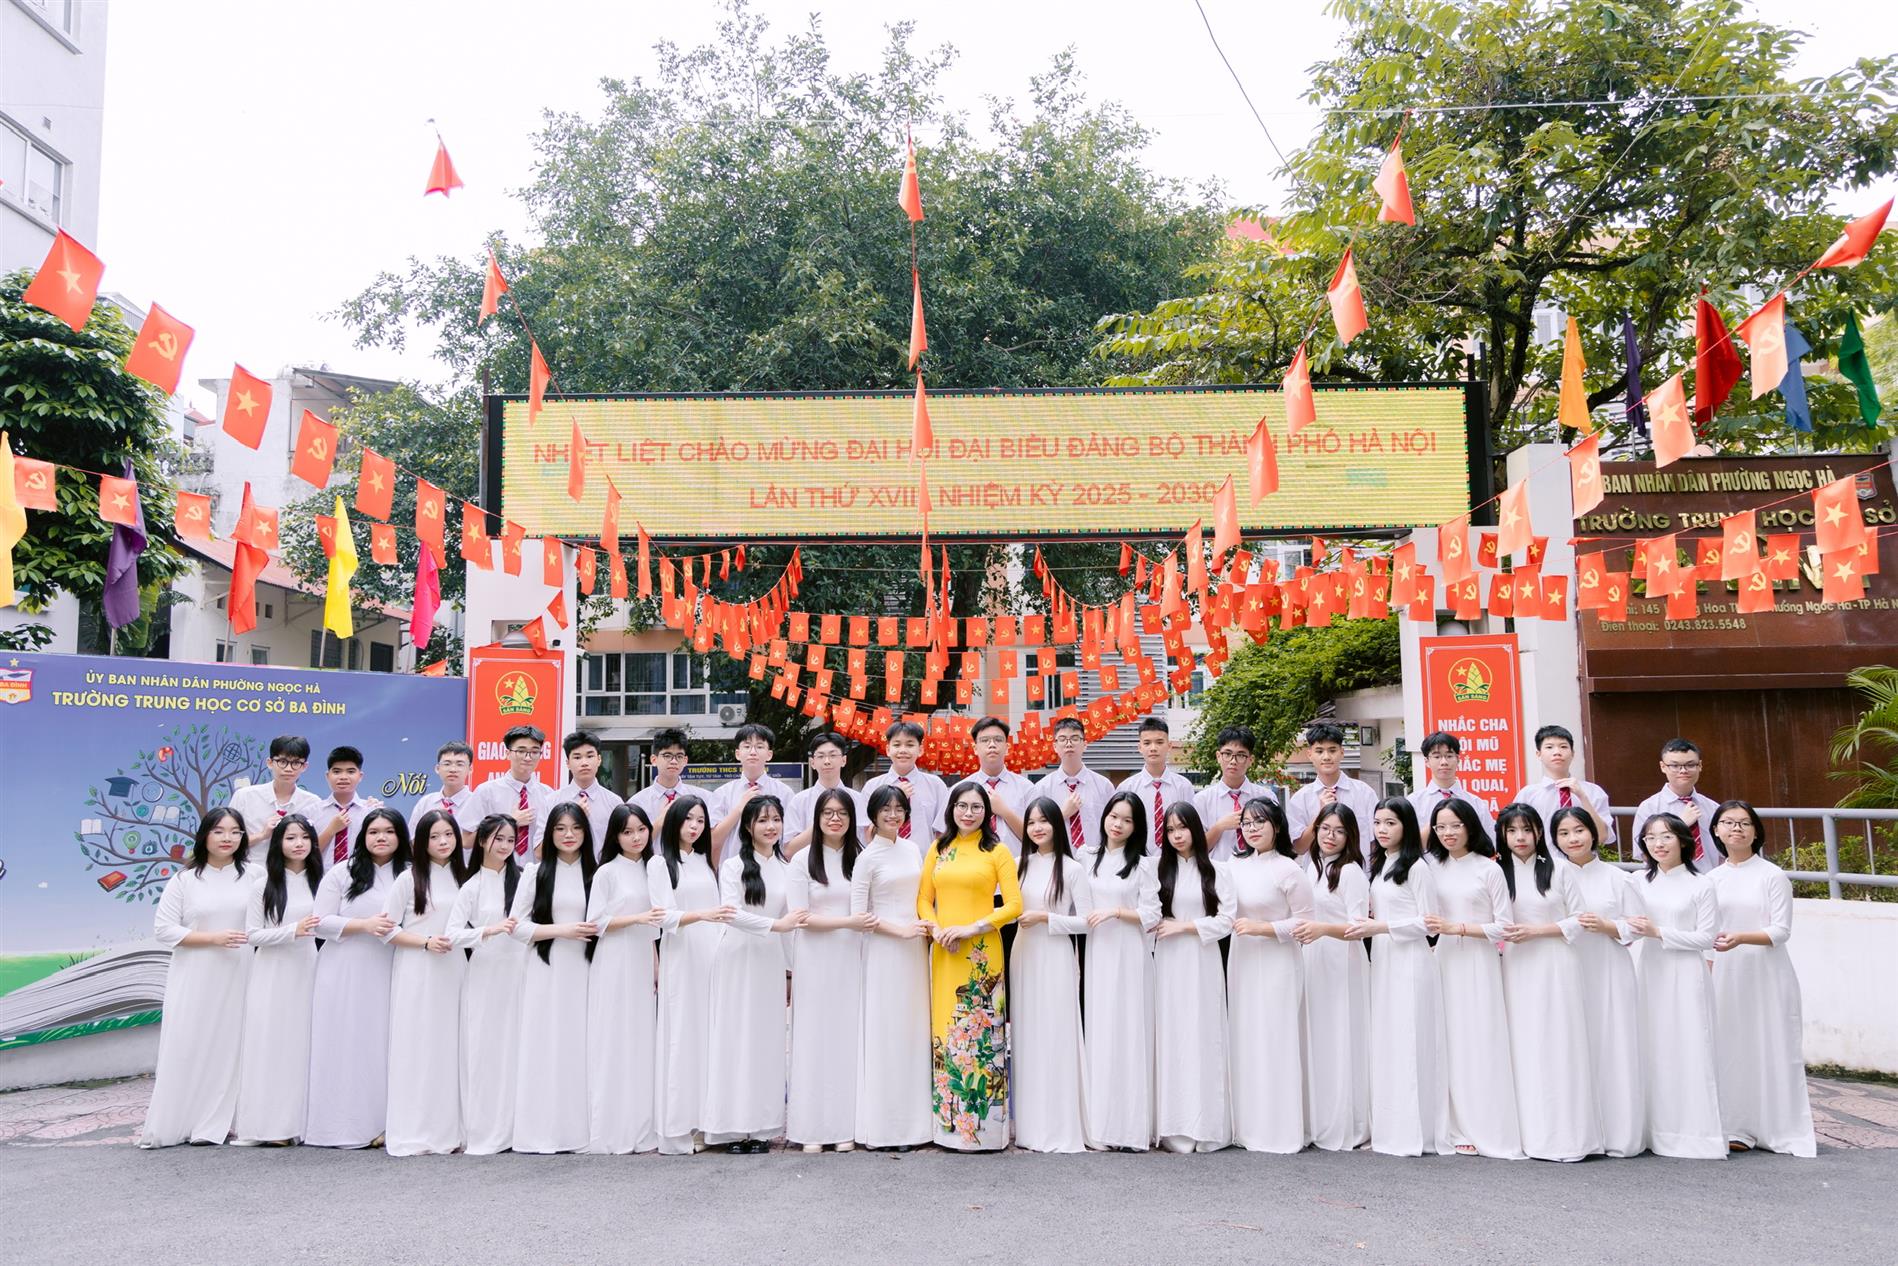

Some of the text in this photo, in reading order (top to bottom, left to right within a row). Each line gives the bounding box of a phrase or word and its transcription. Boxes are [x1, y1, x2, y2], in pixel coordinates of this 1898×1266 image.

[533, 442, 609, 465] NHỆT
[617, 438, 672, 465] LIỆT
[678, 437, 749, 462] CHÀO
[758, 436, 838, 461] MỪNG
[845, 440, 888, 464] ĐẠI
[949, 438, 990, 462] ĐẠI
[1000, 433, 1060, 459] BIỂU
[1066, 432, 1140, 458] ĐẢNG
[1149, 432, 1185, 459] BỘ
[1192, 430, 1279, 456] THÀ
[1287, 429, 1342, 454] PHỐ
[1349, 428, 1384, 453] HÀ
[1391, 428, 1437, 456] NỘI
[1602, 464, 1837, 493] BAN NHÂN DÂN PHƯỜNG NGỌC HÀ
[750, 482, 798, 509] LẦN
[804, 482, 860, 509] THỨ
[867, 485, 919, 508] XVII
[939, 481, 1021, 510] NHIỆM
[1030, 480, 1065, 506] KỲ
[1072, 483, 1133, 505] 2025
[1156, 481, 1217, 504] 2030
[1578, 500, 1897, 532] TRƯỜNG TRU HỌC SỞ
[1641, 603, 1661, 615] 145
[1703, 602, 1727, 613] Hoa
[1873, 597, 1890, 609] Hà
[1664, 619, 1747, 631] 0243.823.5548
[86, 669, 321, 695] ỦY BAN NHÂN DÂN PHƯỜNG NGỌC HÀ
[52, 690, 346, 715] TRƯỜNG TRUNG HỌC CƠ SỞ BA ĐÌNH
[1438, 715, 1508, 732] NHẮC CHA
[1459, 736, 1499, 754] ỘI MŨ
[1485, 758, 1507, 775] MẸ
[382, 772, 427, 797] Nối
[1471, 779, 1509, 793] QUAI,
